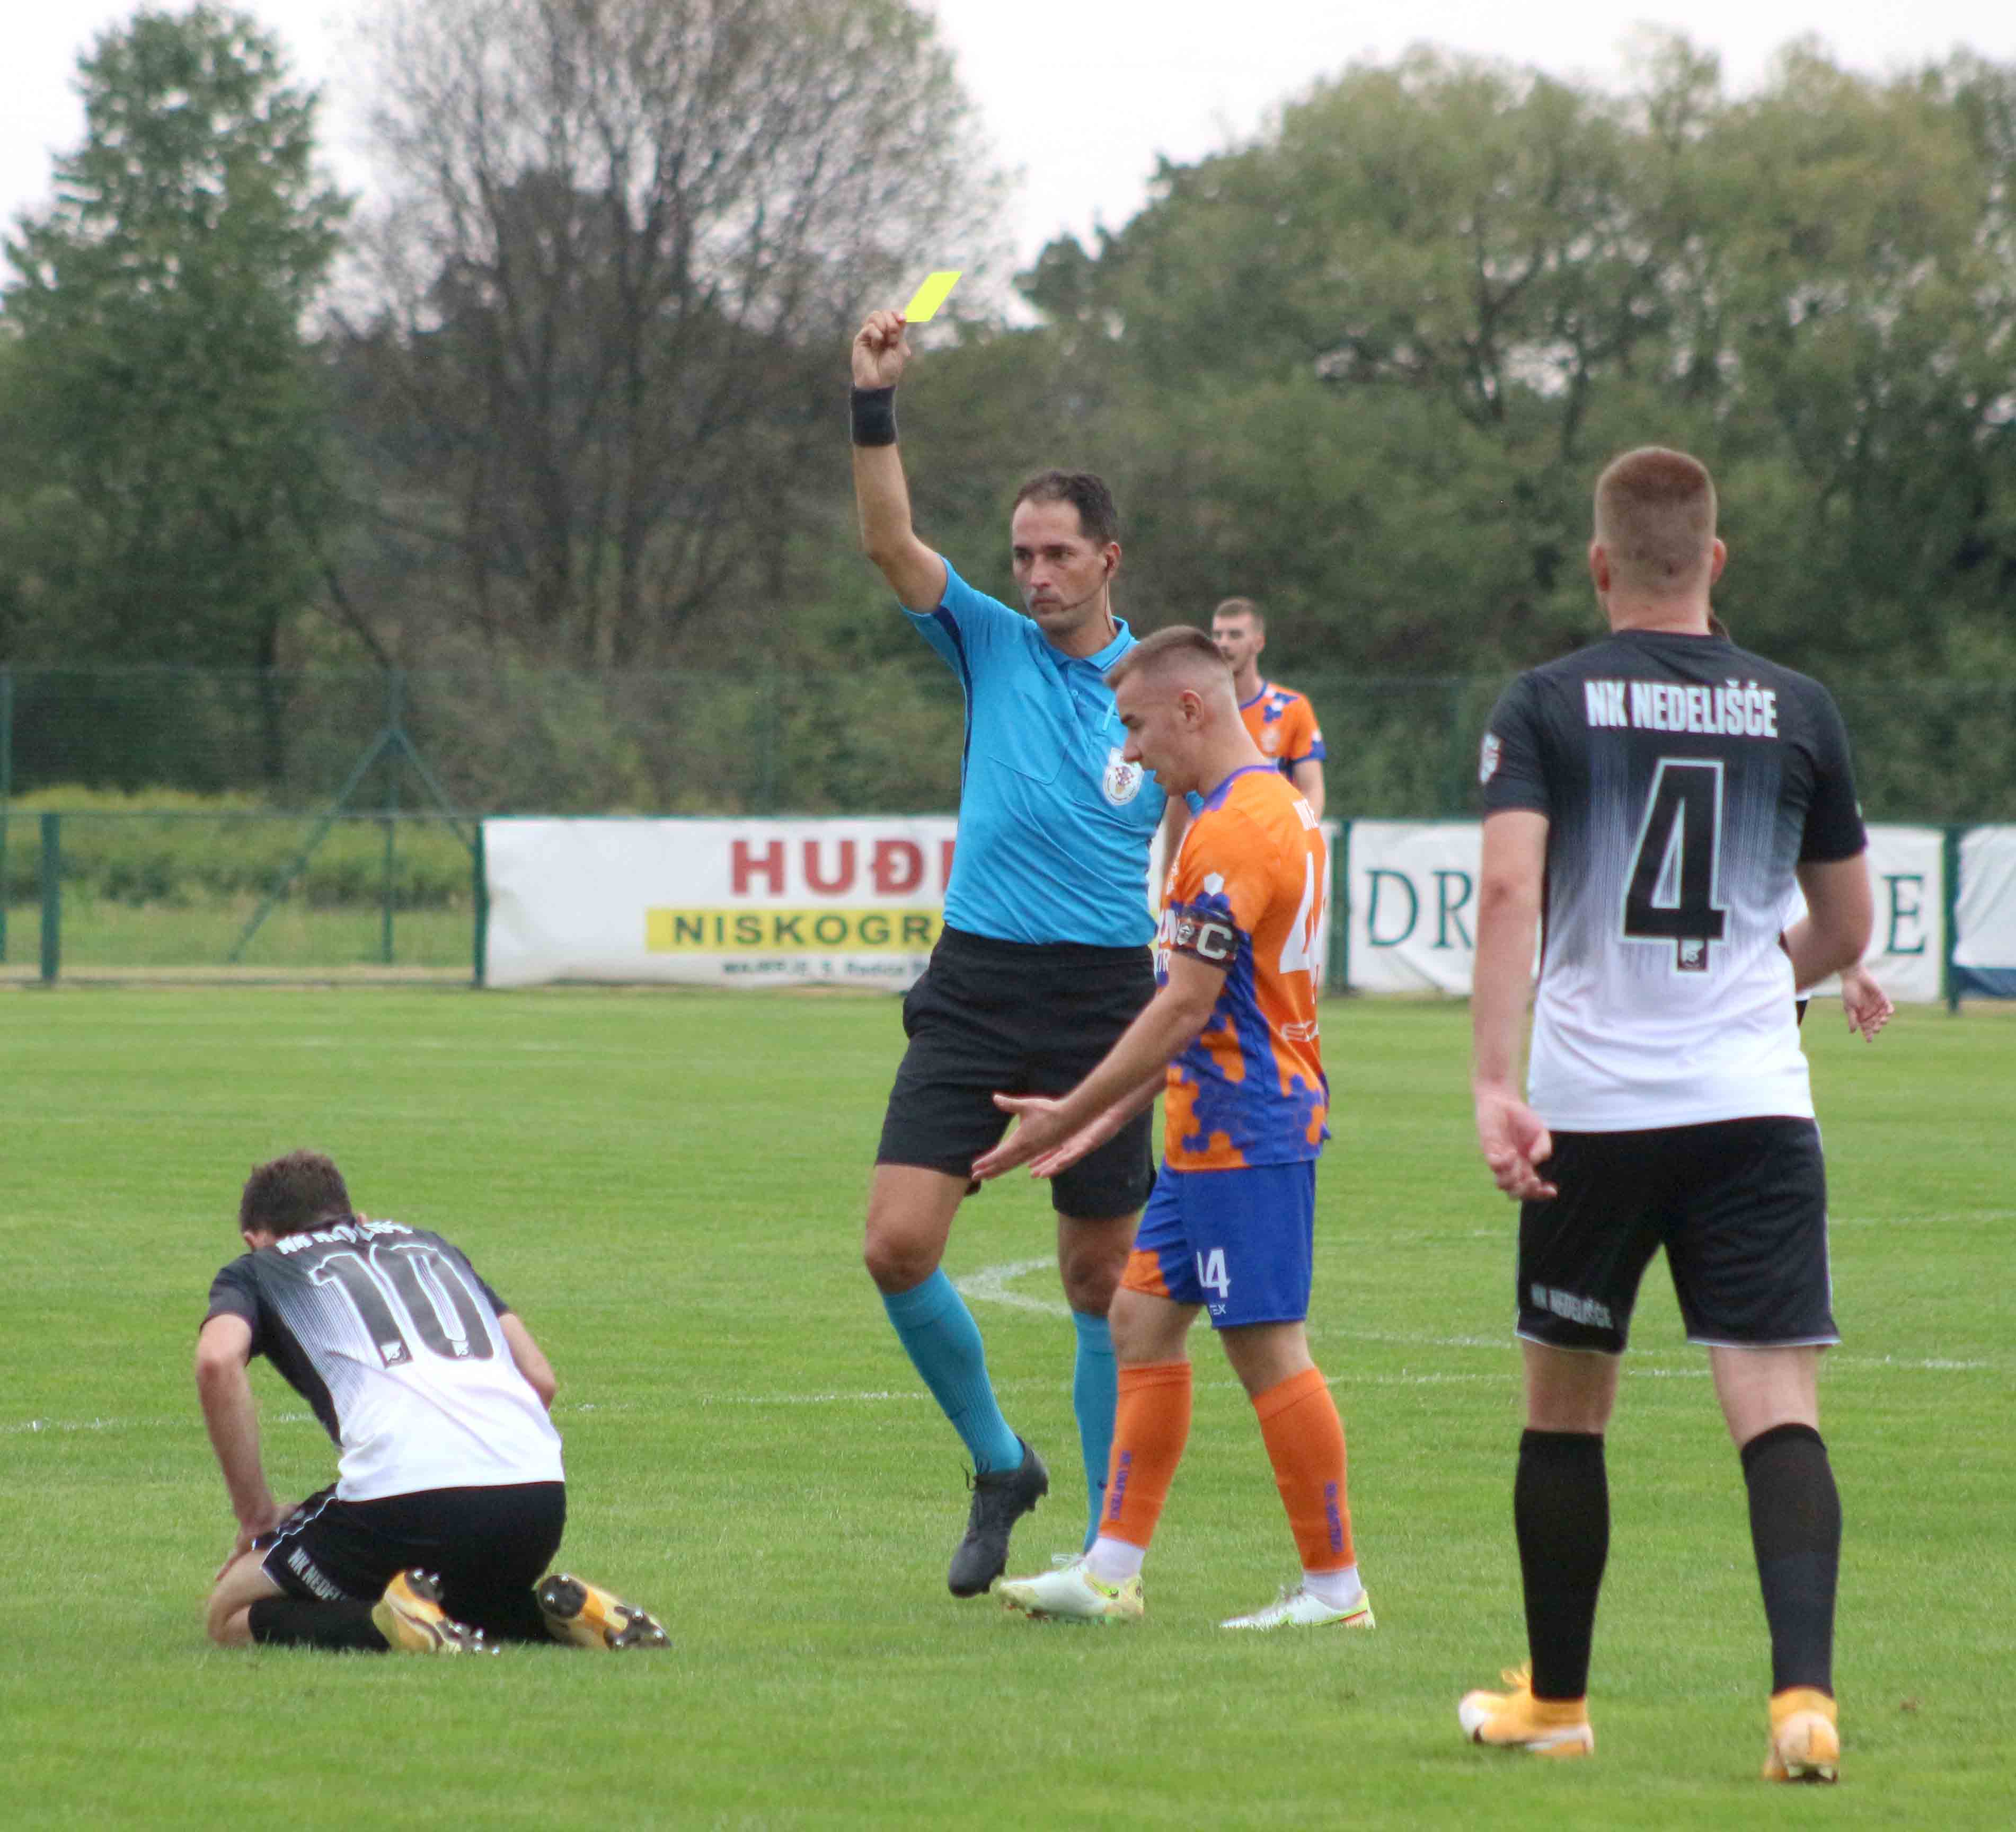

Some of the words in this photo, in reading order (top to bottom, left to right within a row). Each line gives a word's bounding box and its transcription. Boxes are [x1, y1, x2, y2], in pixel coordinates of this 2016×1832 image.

[1584, 680, 1628, 727] NK
[1621, 758, 1731, 974] 4
[673, 914, 932, 946] NISKOGR
[1197, 922, 1233, 960] C
[309, 1243, 494, 1370] 10
